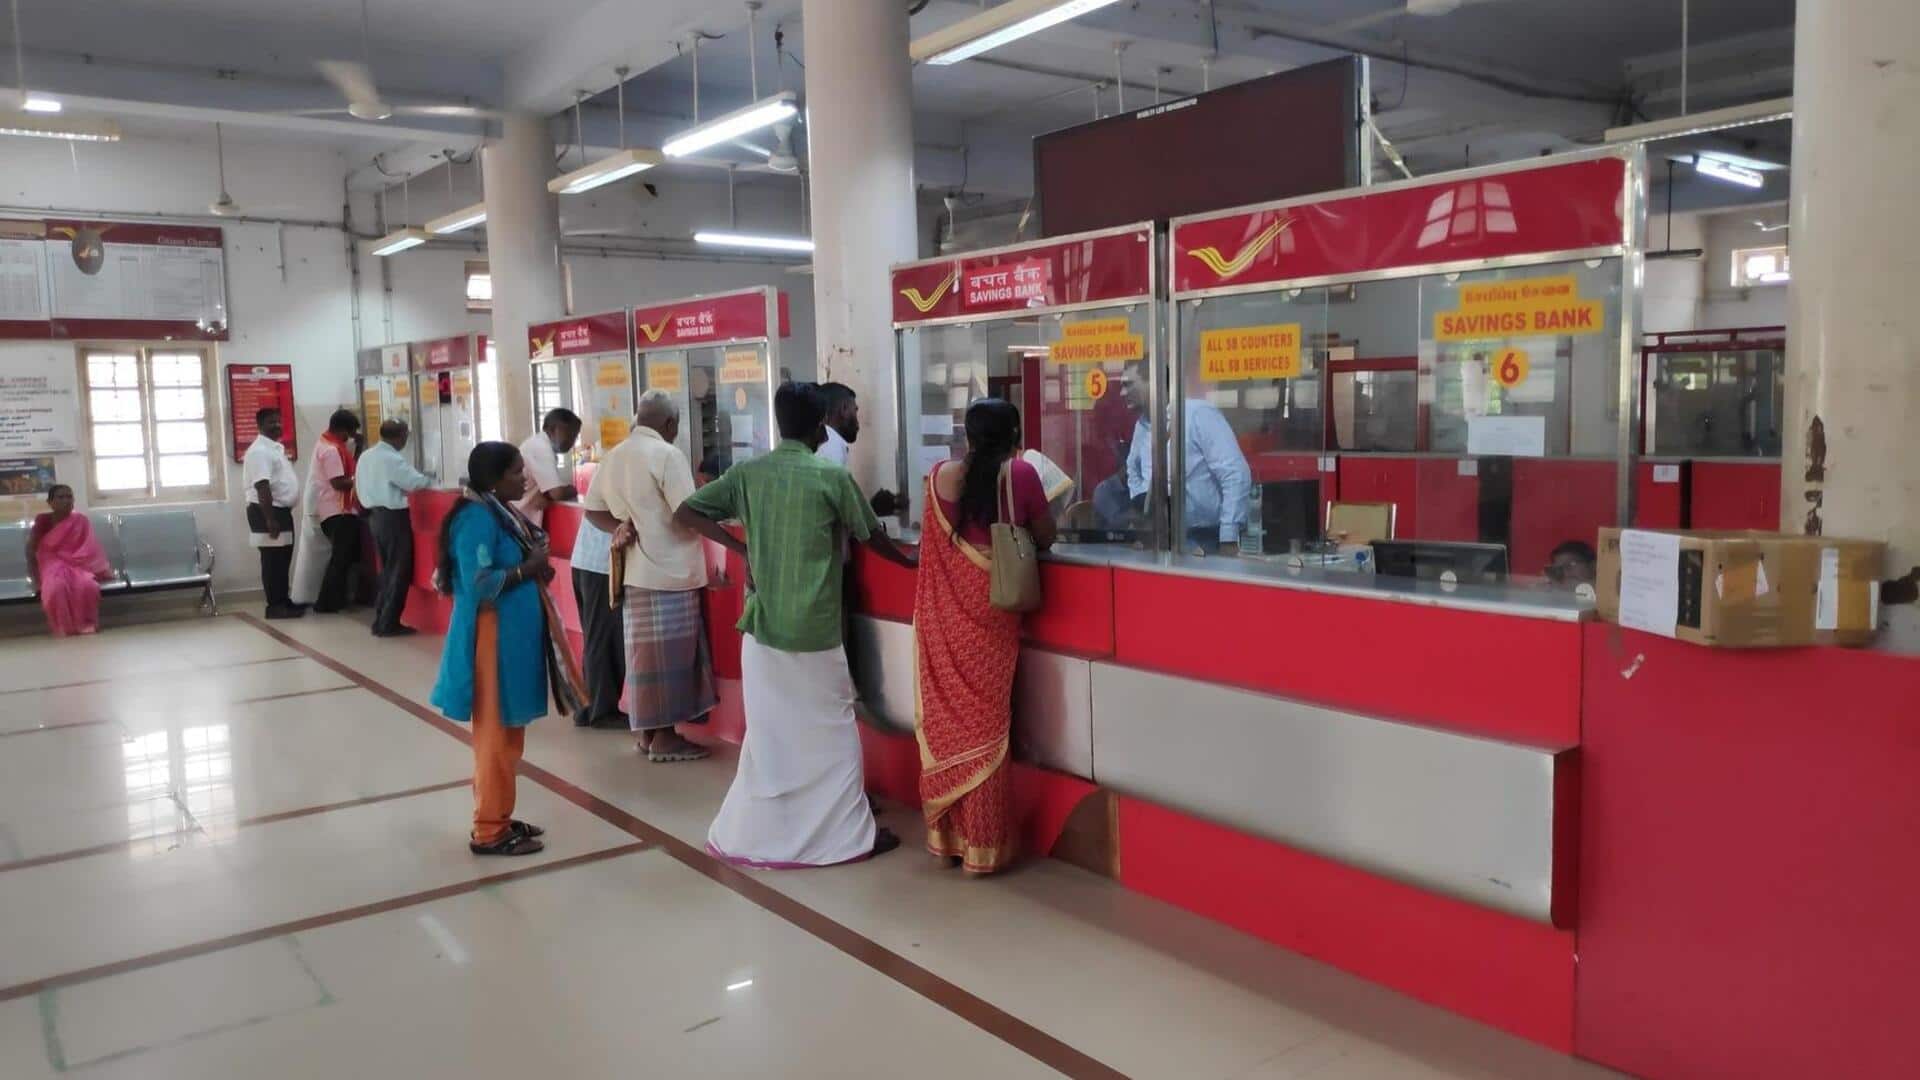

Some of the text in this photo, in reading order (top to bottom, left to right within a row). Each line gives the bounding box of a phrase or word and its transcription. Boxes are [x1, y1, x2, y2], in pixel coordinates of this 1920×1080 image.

[969, 271, 1008, 289] बचत
[969, 283, 1042, 304] SAVINGS BANK
[1442, 306, 1593, 336] SAVINGS BANK
[1053, 340, 1137, 361] SAVINGS BANK
[1207, 337, 1224, 352] ALL
[1240, 332, 1293, 350] COUNTERS
[1208, 359, 1225, 374] ALL
[1243, 356, 1290, 372] SERVICES
[1500, 352, 1520, 385] 6
[1091, 372, 1101, 397] 5
